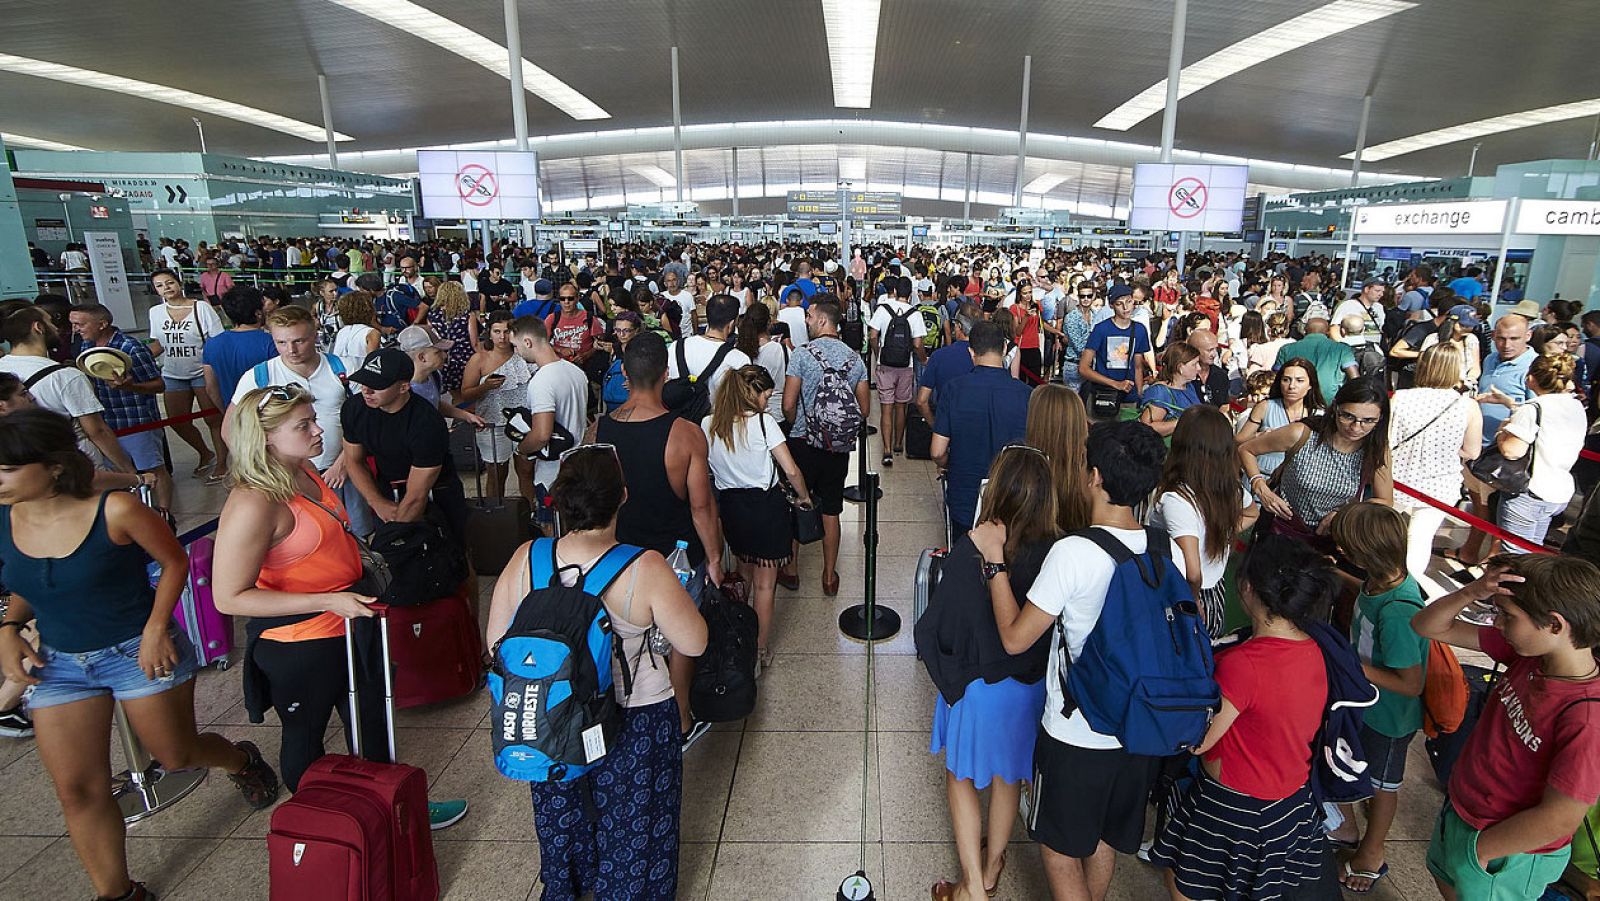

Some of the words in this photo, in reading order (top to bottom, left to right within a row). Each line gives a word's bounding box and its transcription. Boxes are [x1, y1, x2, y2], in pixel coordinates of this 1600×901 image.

[1395, 208, 1471, 229] exchange
[1546, 207, 1600, 225] camb
[162, 320, 193, 331] SAVE
[165, 332, 185, 344] THE
[521, 684, 539, 741] NOROESTE
[503, 711, 517, 741] PASO
